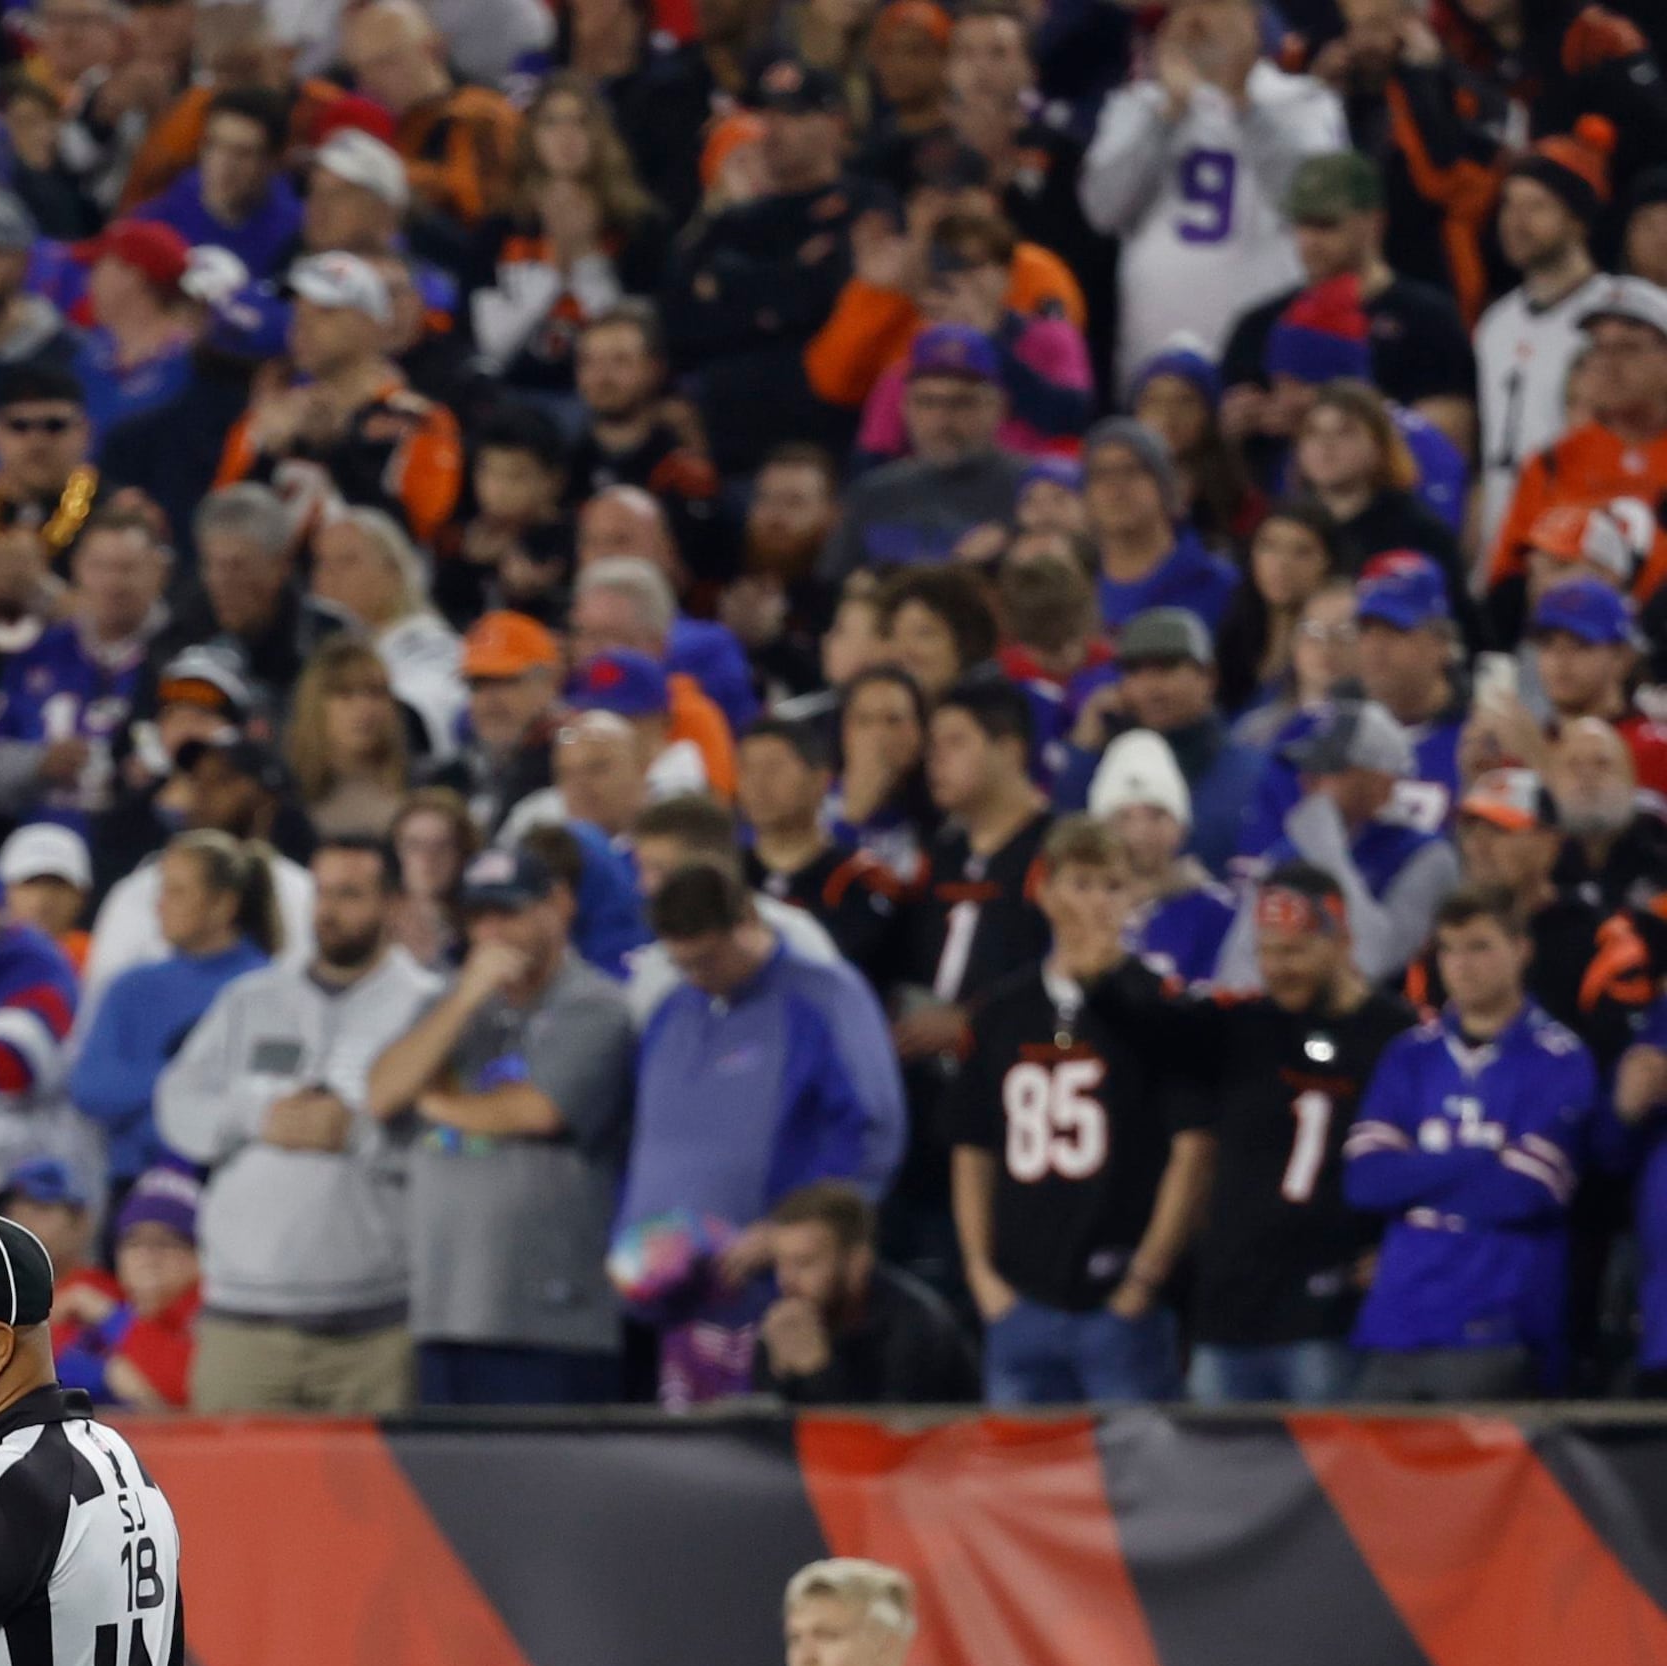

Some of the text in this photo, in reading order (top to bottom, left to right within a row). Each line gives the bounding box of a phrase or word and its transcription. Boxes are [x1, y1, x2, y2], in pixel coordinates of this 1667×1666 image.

[1177, 147, 1236, 244] 9
[932, 899, 981, 1001] 1
[1002, 1056, 1109, 1184] 85
[1280, 1089, 1332, 1202] 1
[117, 1490, 146, 1534] SJ
[120, 1536, 165, 1613] 18
